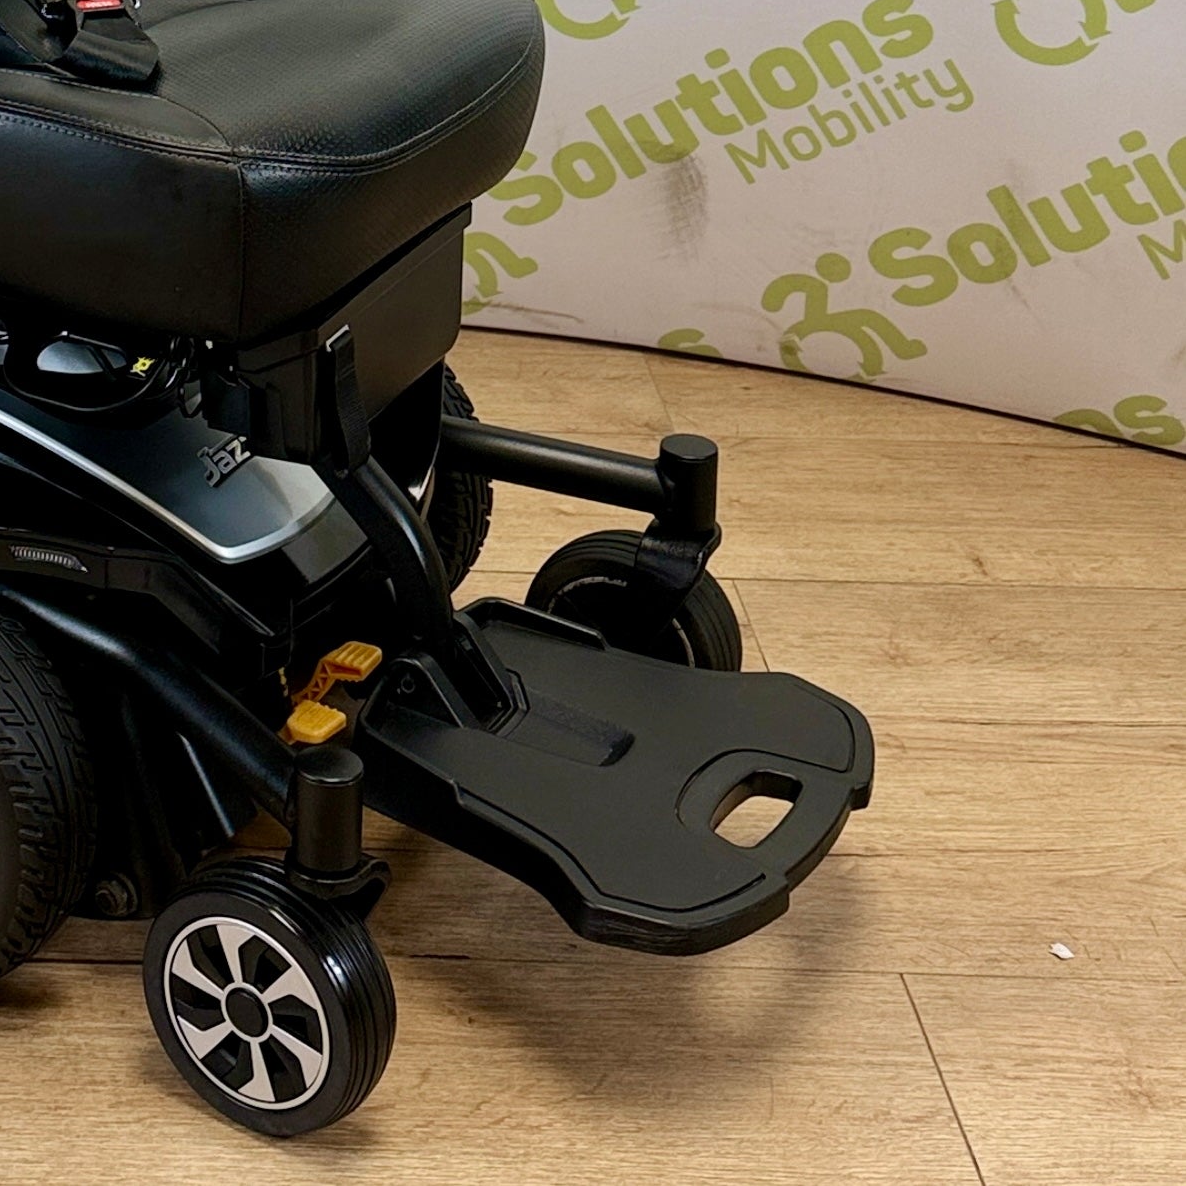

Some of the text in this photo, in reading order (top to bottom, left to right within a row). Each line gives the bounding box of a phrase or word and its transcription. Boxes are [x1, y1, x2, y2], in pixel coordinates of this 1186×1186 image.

[725, 59, 974, 184] Mobility
[868, 129, 1186, 307] Soluti
[197, 435, 251, 487] Jaz
